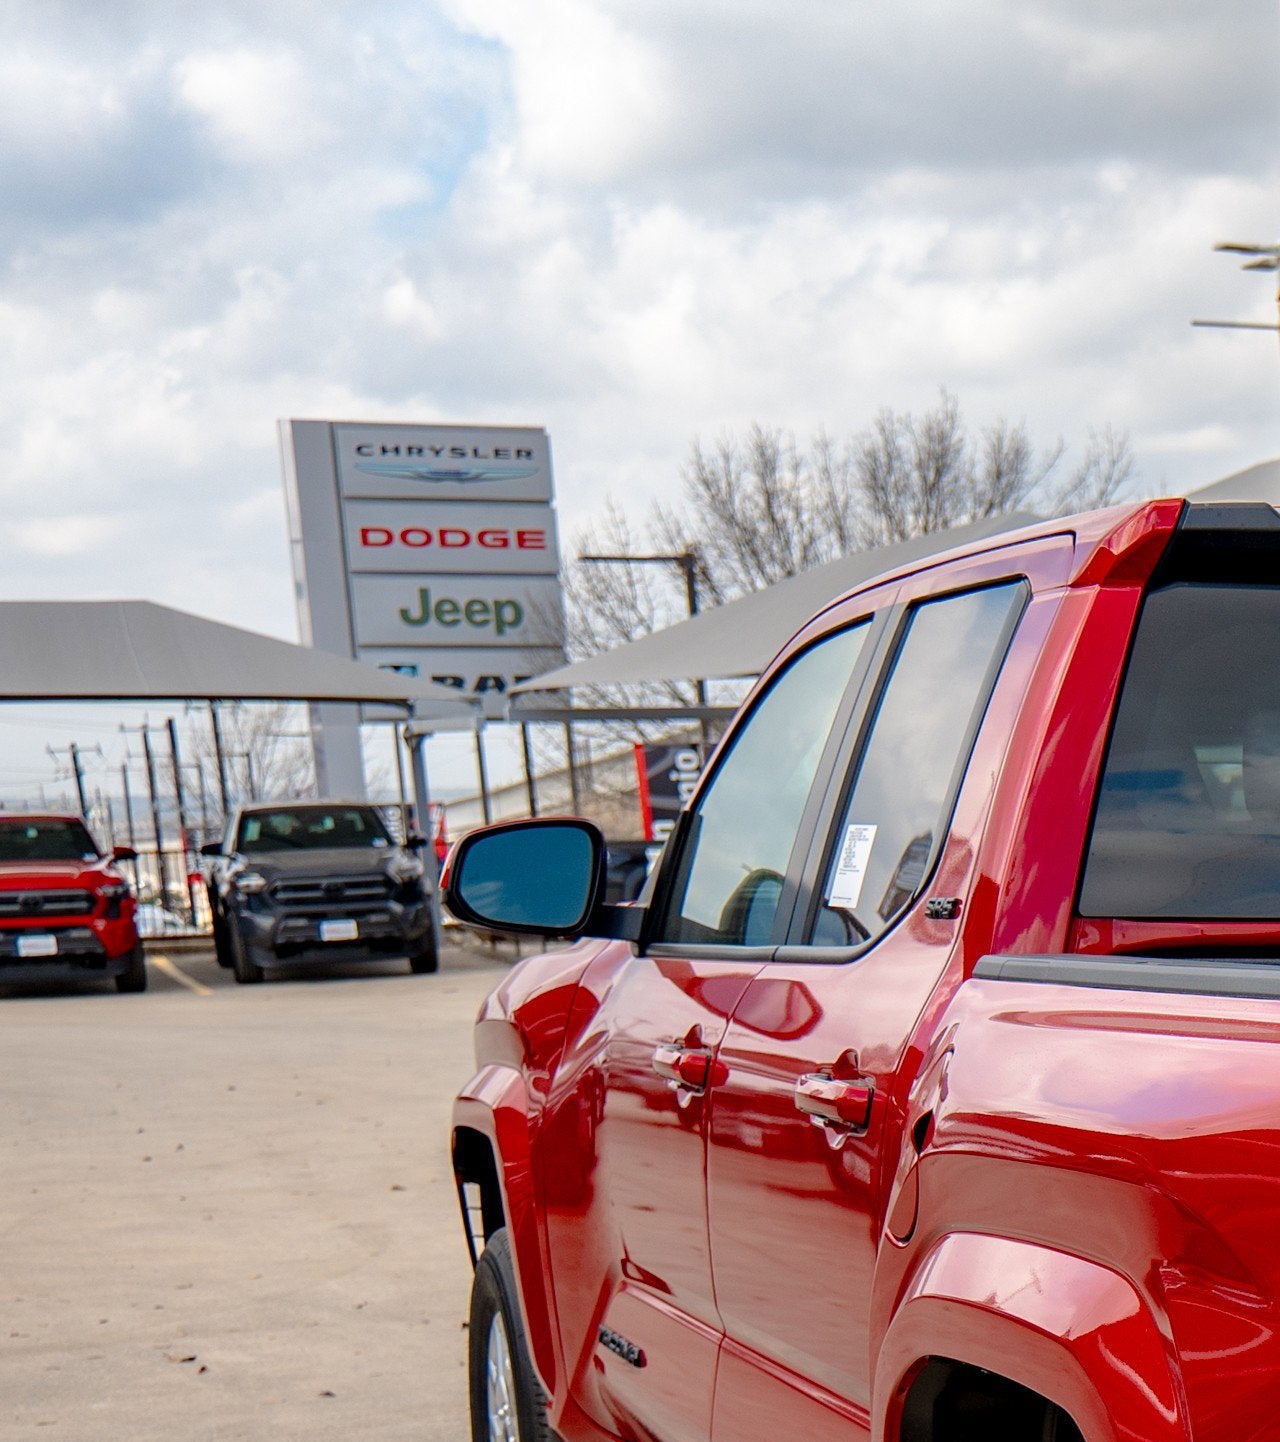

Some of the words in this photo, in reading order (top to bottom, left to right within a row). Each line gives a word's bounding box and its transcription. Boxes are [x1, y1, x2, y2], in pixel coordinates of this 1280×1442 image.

[355, 443, 534, 461] CHRYSLER
[360, 527, 547, 549] DODGE
[400, 586, 524, 636] Jeep
